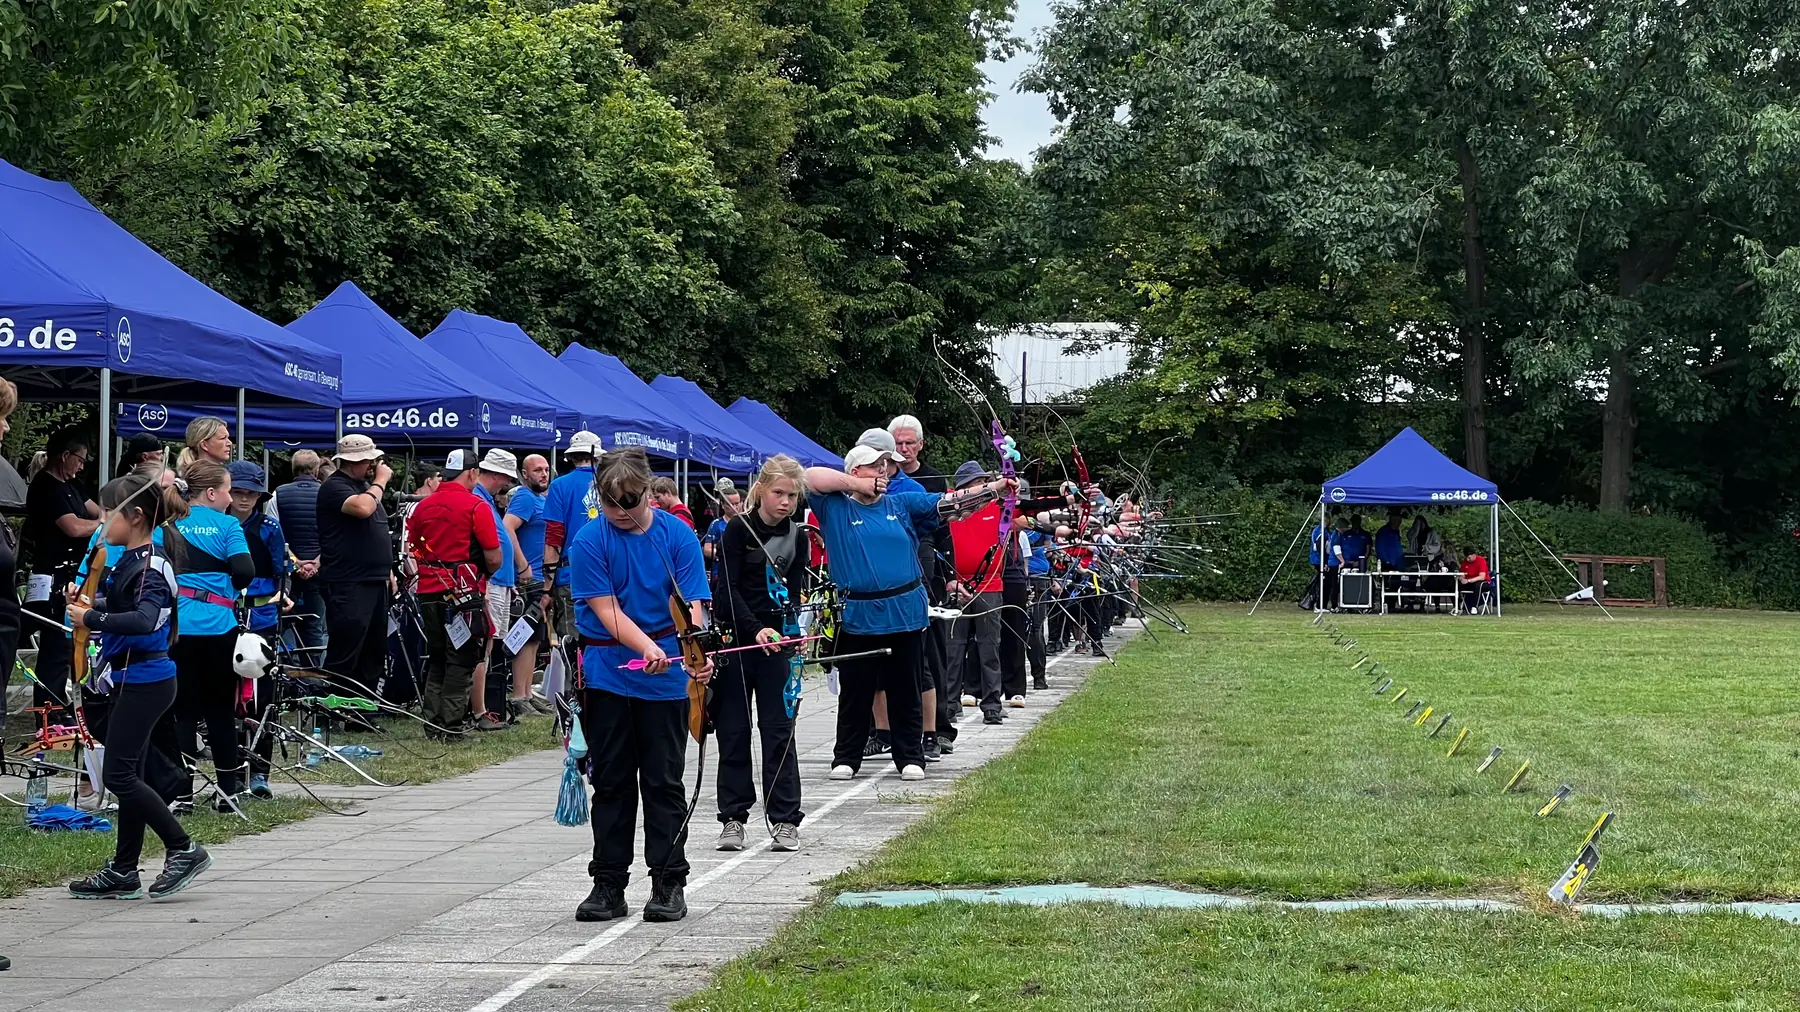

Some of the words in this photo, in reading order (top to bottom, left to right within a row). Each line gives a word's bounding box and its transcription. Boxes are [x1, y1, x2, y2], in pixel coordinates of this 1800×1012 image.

[120, 332, 130, 347] ASC
[141, 411, 165, 420] ASC
[346, 408, 459, 428] asc46.de
[1431, 490, 1488, 500] asc46.de
[178, 525, 219, 536] Zwinge
